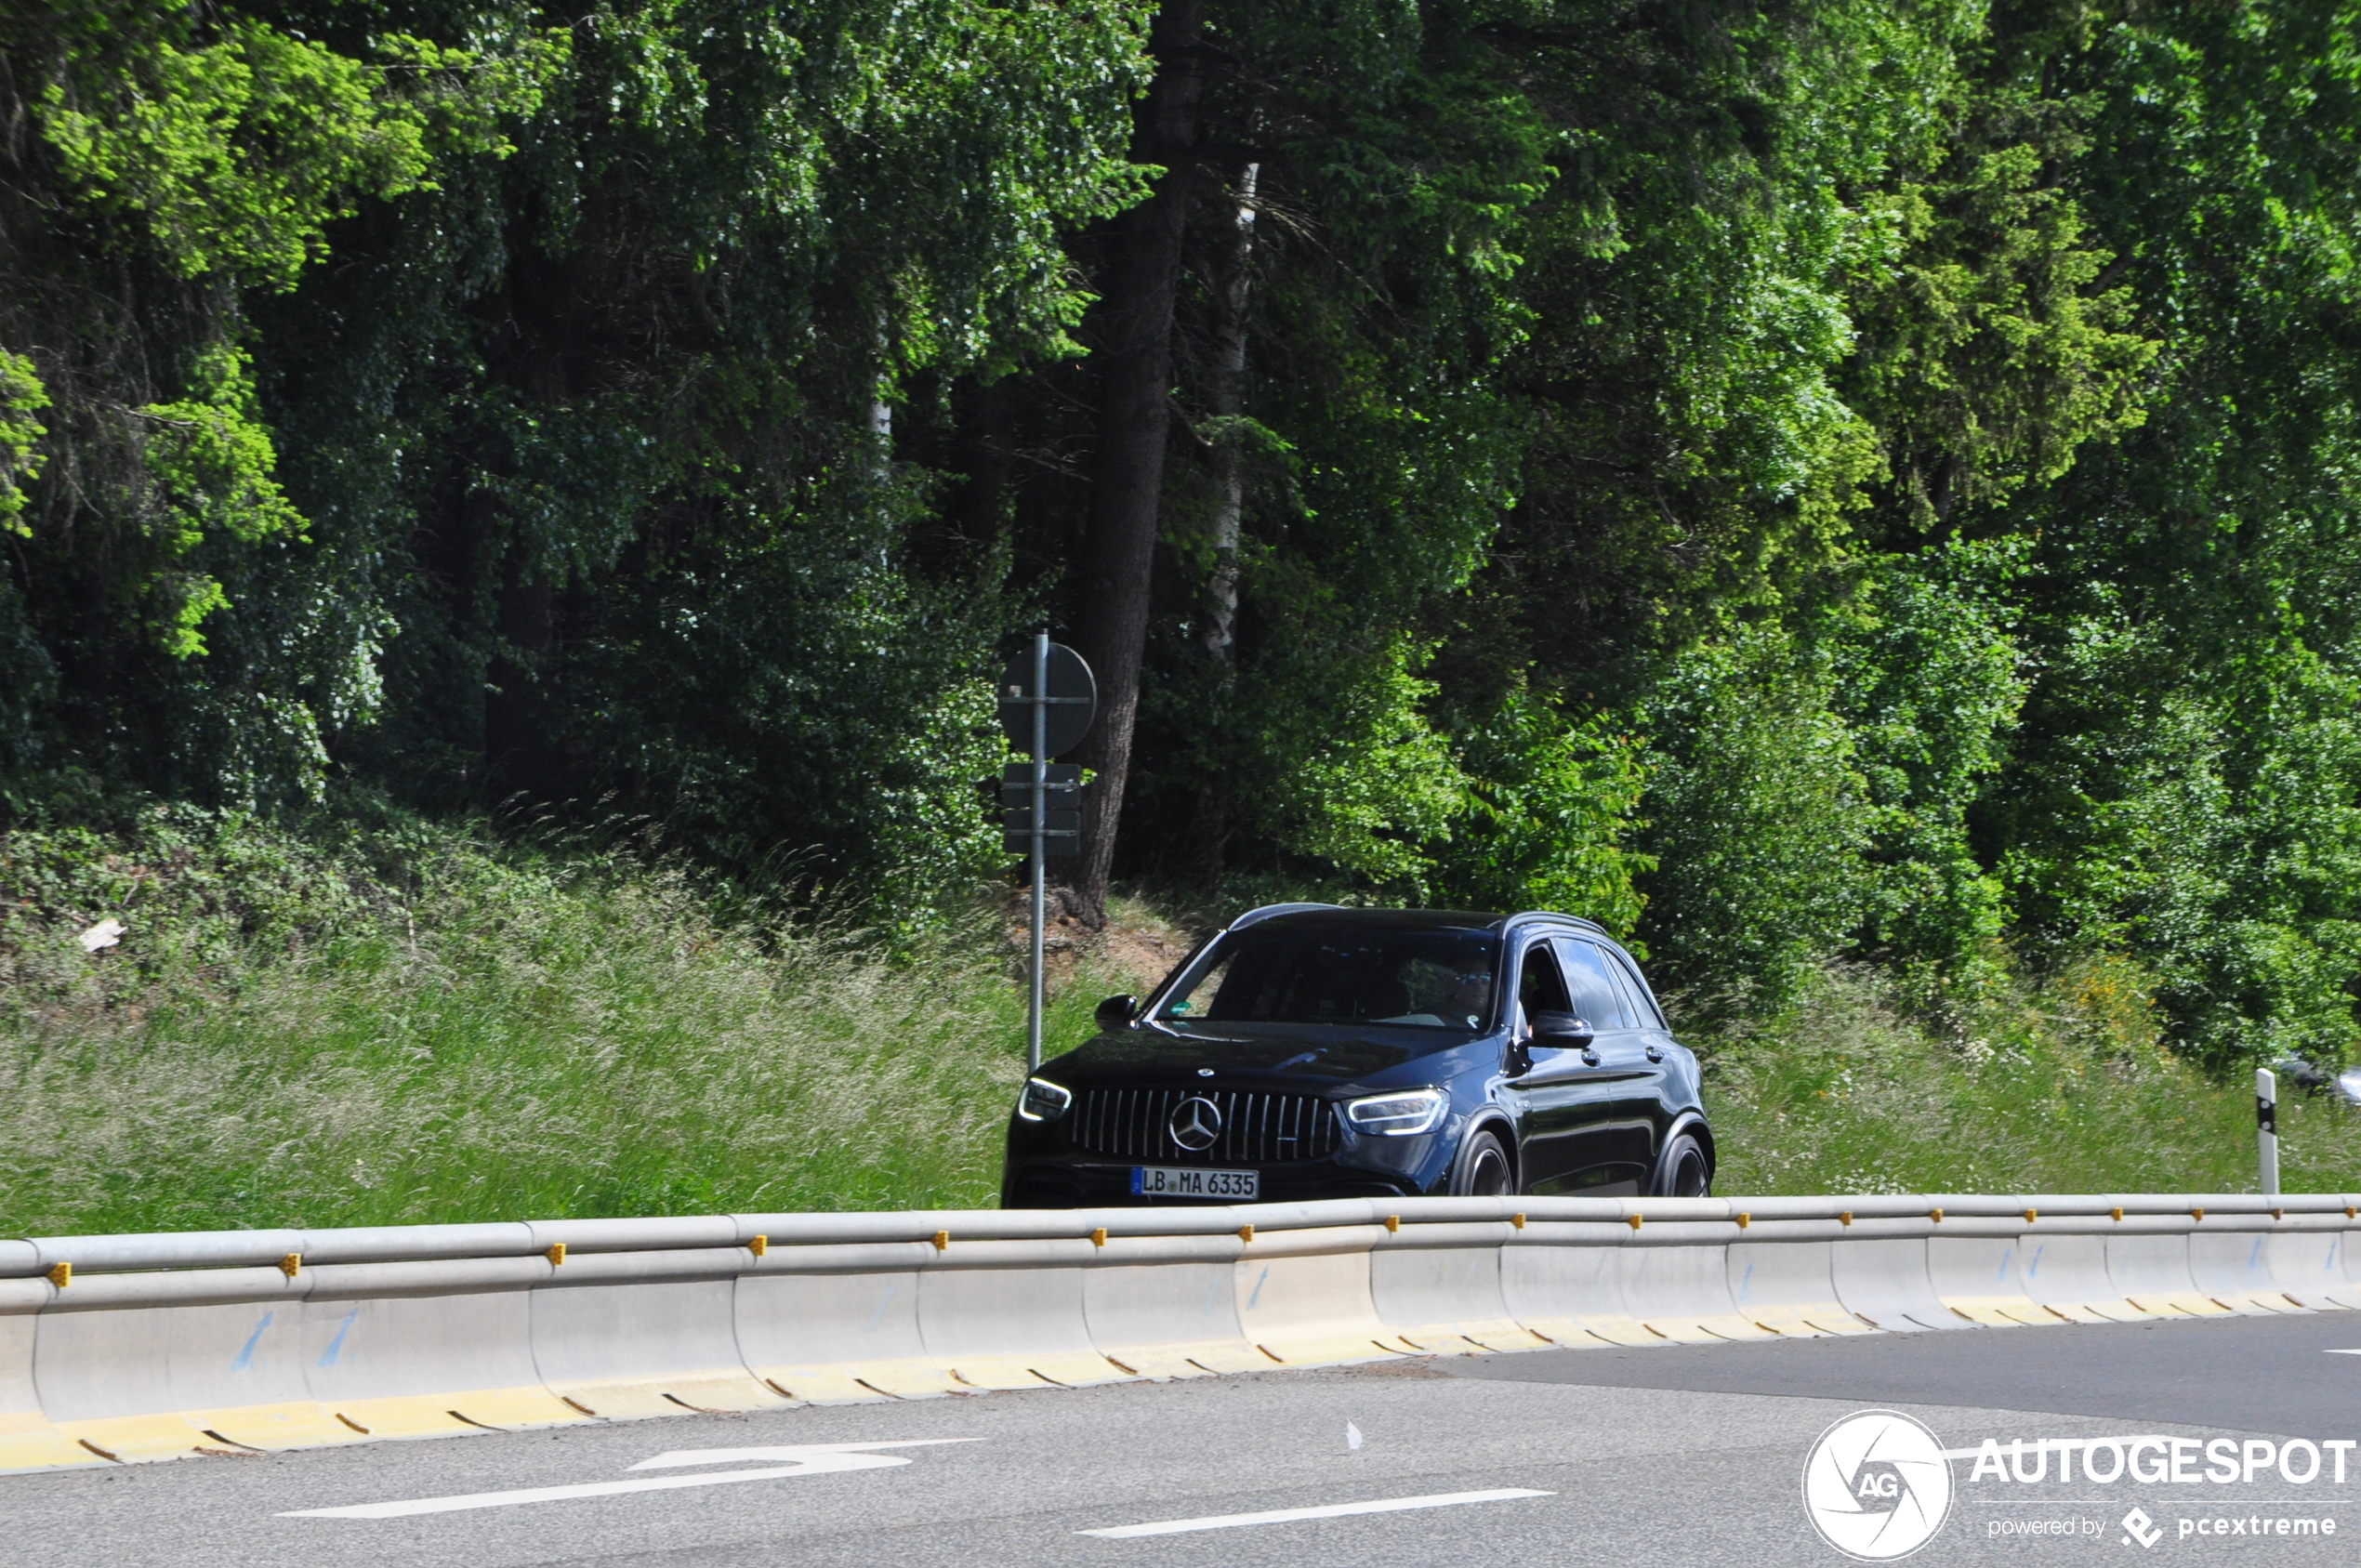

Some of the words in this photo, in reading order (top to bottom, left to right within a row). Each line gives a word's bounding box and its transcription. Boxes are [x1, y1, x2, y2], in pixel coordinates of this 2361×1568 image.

[1142, 1169, 1166, 1192] LB
[1179, 1171, 1203, 1193] MA
[1207, 1173, 1255, 1195] 6335
